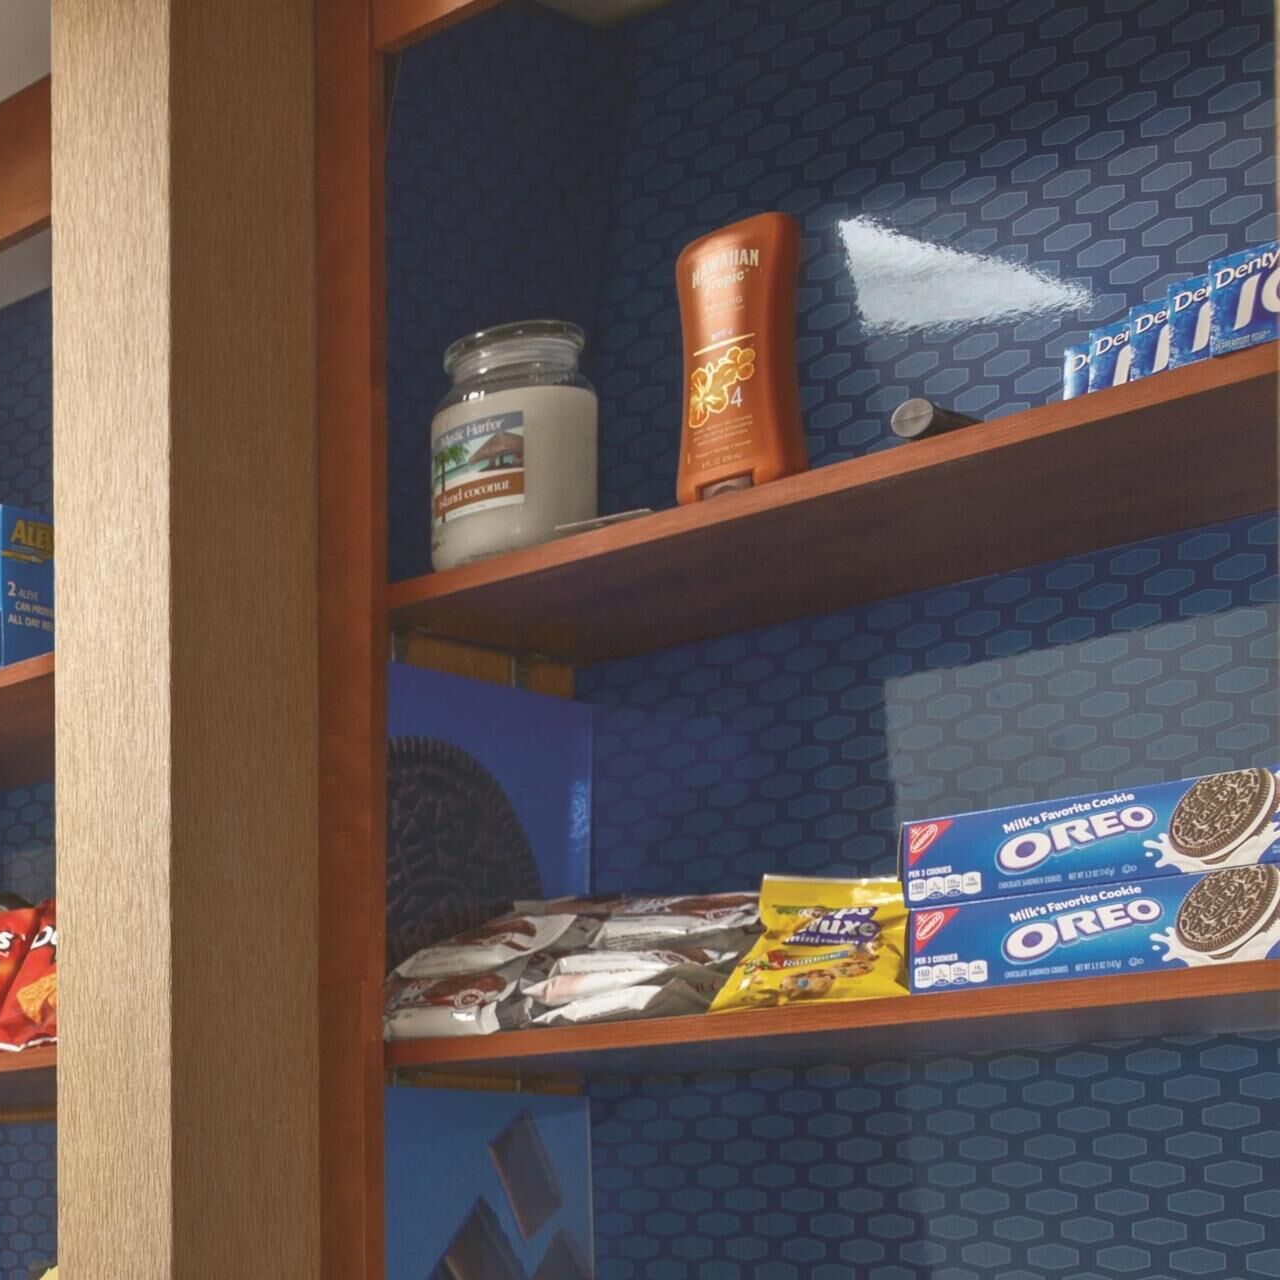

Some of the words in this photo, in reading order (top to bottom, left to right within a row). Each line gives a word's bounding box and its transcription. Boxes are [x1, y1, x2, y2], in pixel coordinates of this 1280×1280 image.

[692, 249, 759, 288] HAWAIIAN
[1215, 250, 1280, 289] Denty
[1232, 264, 1280, 331] IC
[730, 386, 743, 408] 4
[466, 418, 505, 437] Harbor
[464, 480, 511, 498] coconut
[7, 581, 17, 597] 2
[8, 613, 22, 625] ALL
[25, 615, 41, 627] DAY
[1003, 815, 1040, 834] Milk's
[1039, 803, 1092, 823] Favorite
[1092, 791, 1136, 809] Cookie
[999, 805, 1156, 870] OREO
[1009, 906, 1047, 924] Milk's
[1046, 893, 1098, 913] Favorite
[1099, 885, 1142, 901] Cookie
[809, 917, 877, 936] luxe
[1006, 899, 1162, 960] OREO
